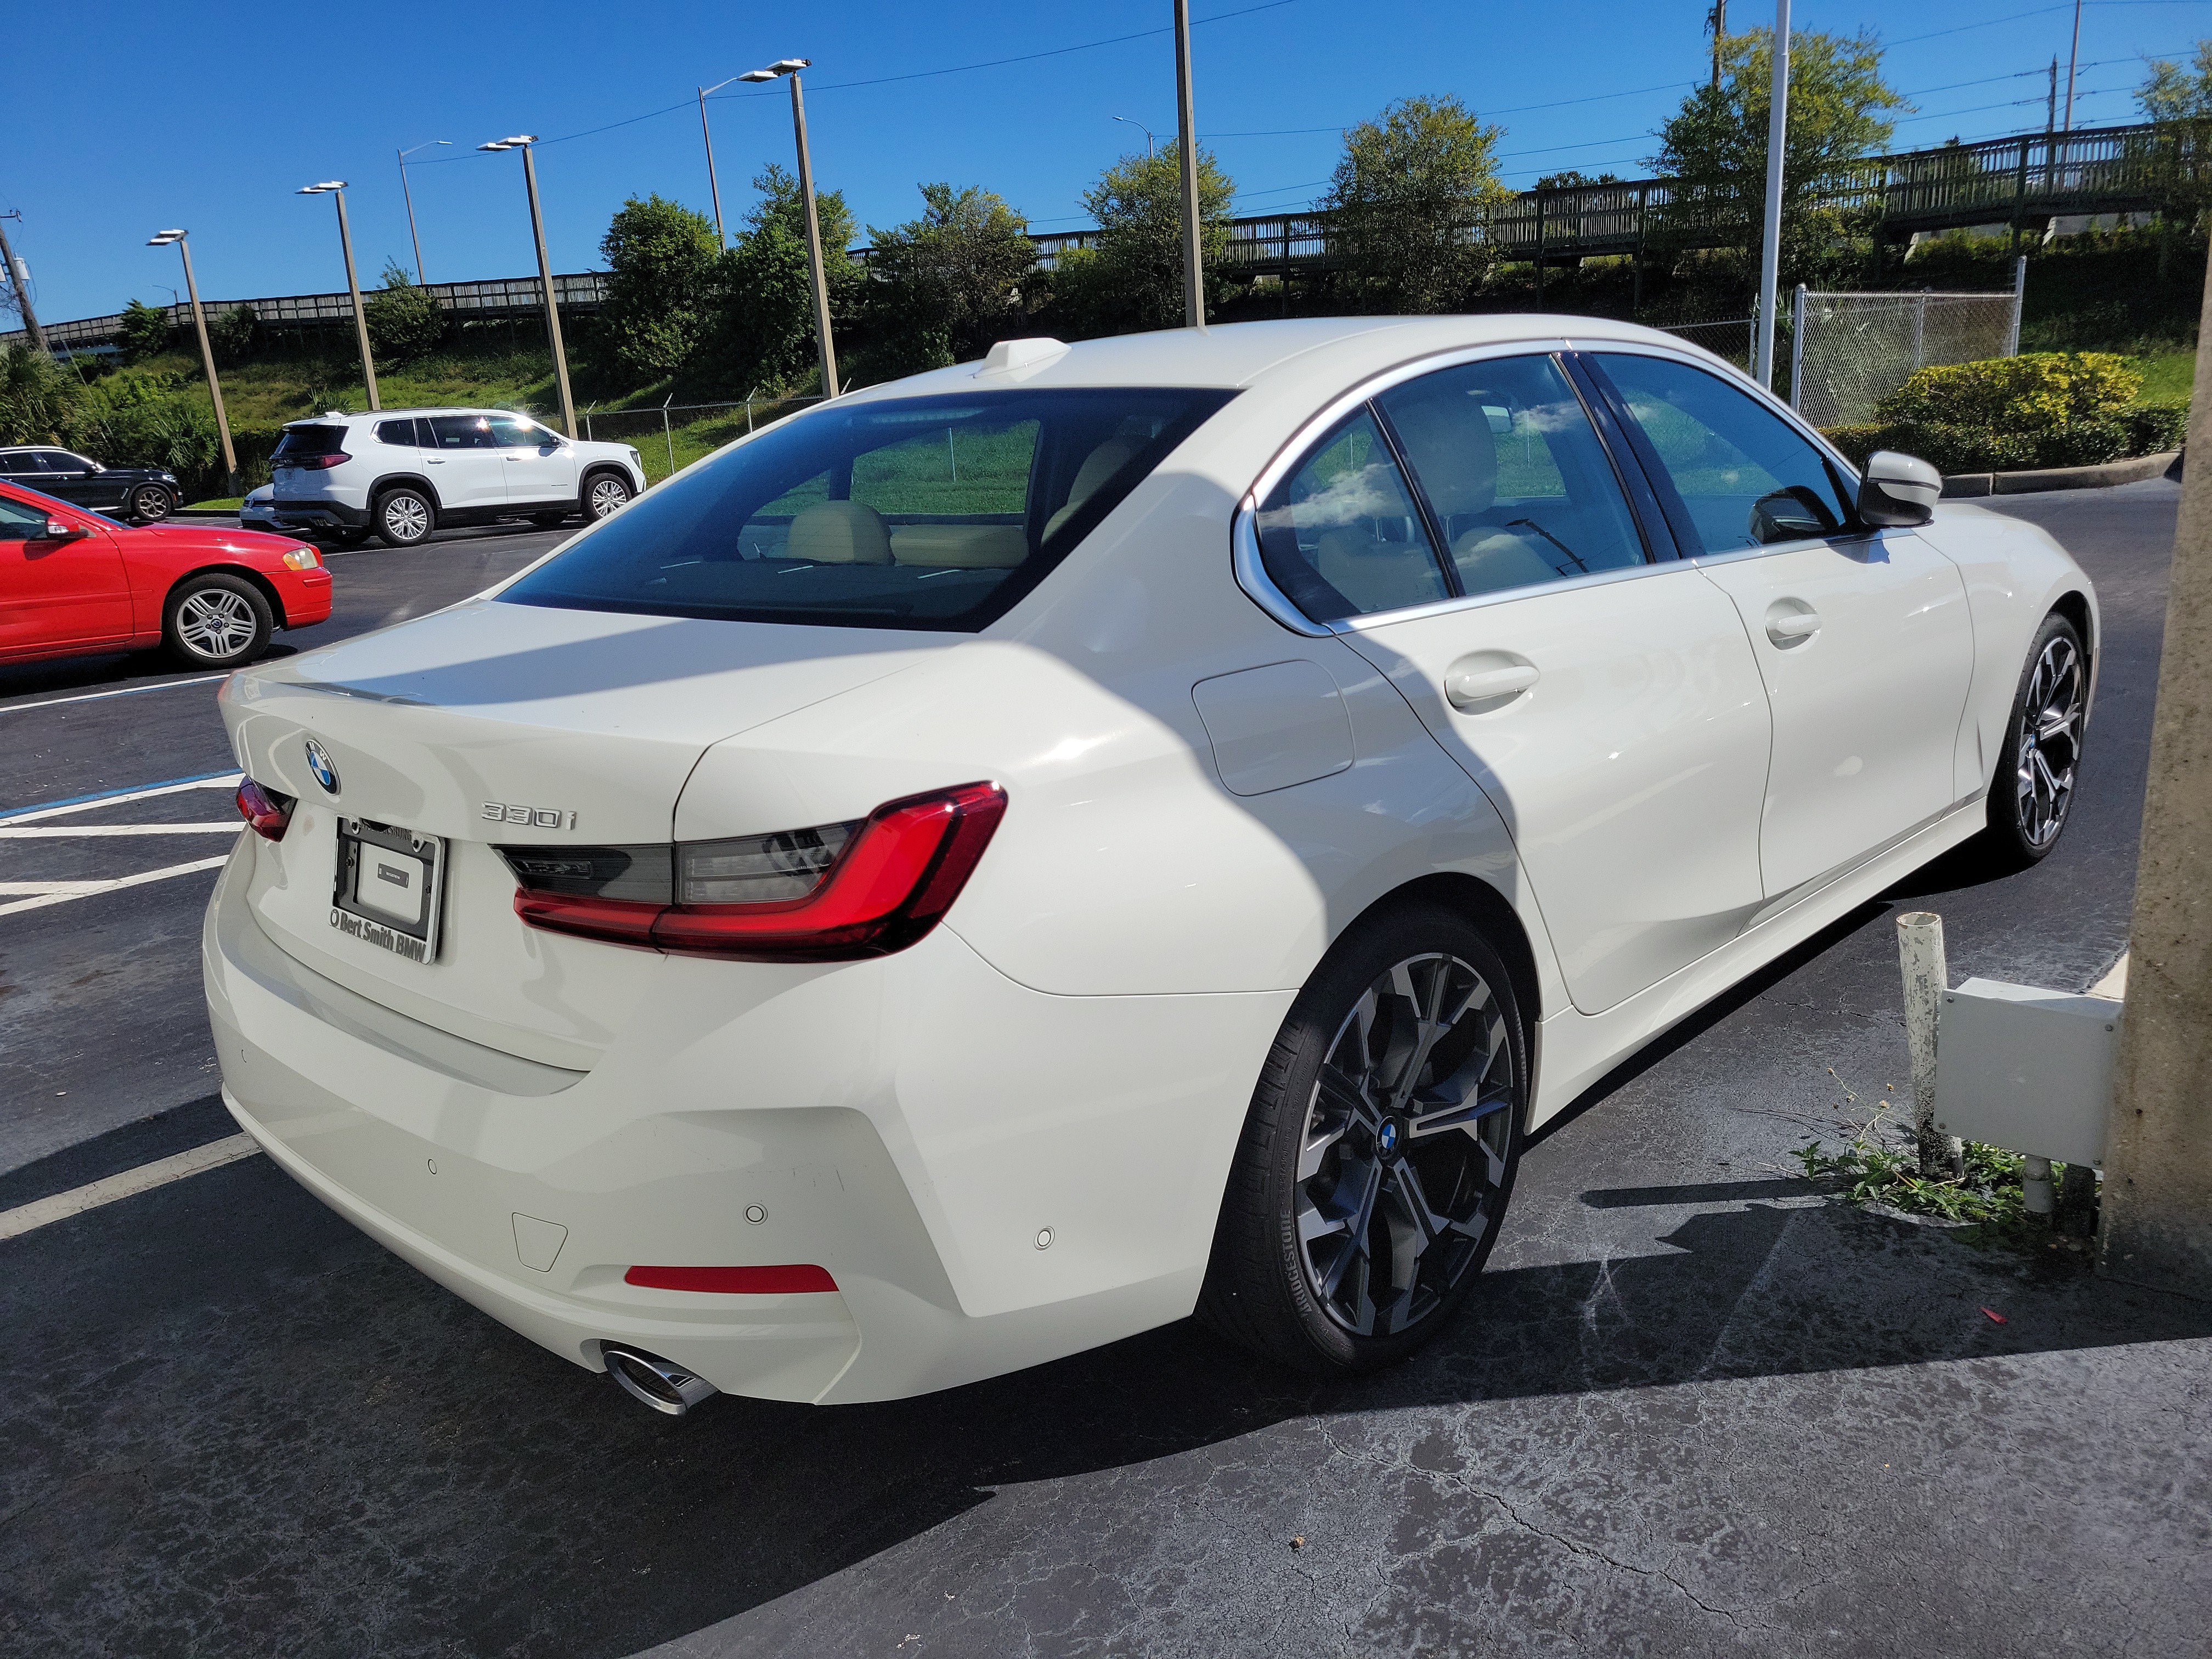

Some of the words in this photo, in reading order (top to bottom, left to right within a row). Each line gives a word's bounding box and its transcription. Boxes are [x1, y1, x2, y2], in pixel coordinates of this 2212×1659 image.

[481, 801, 577, 831] 330i
[340, 912, 362, 938] Bert
[363, 922, 394, 951] Smith
[396, 934, 426, 963] BMW
